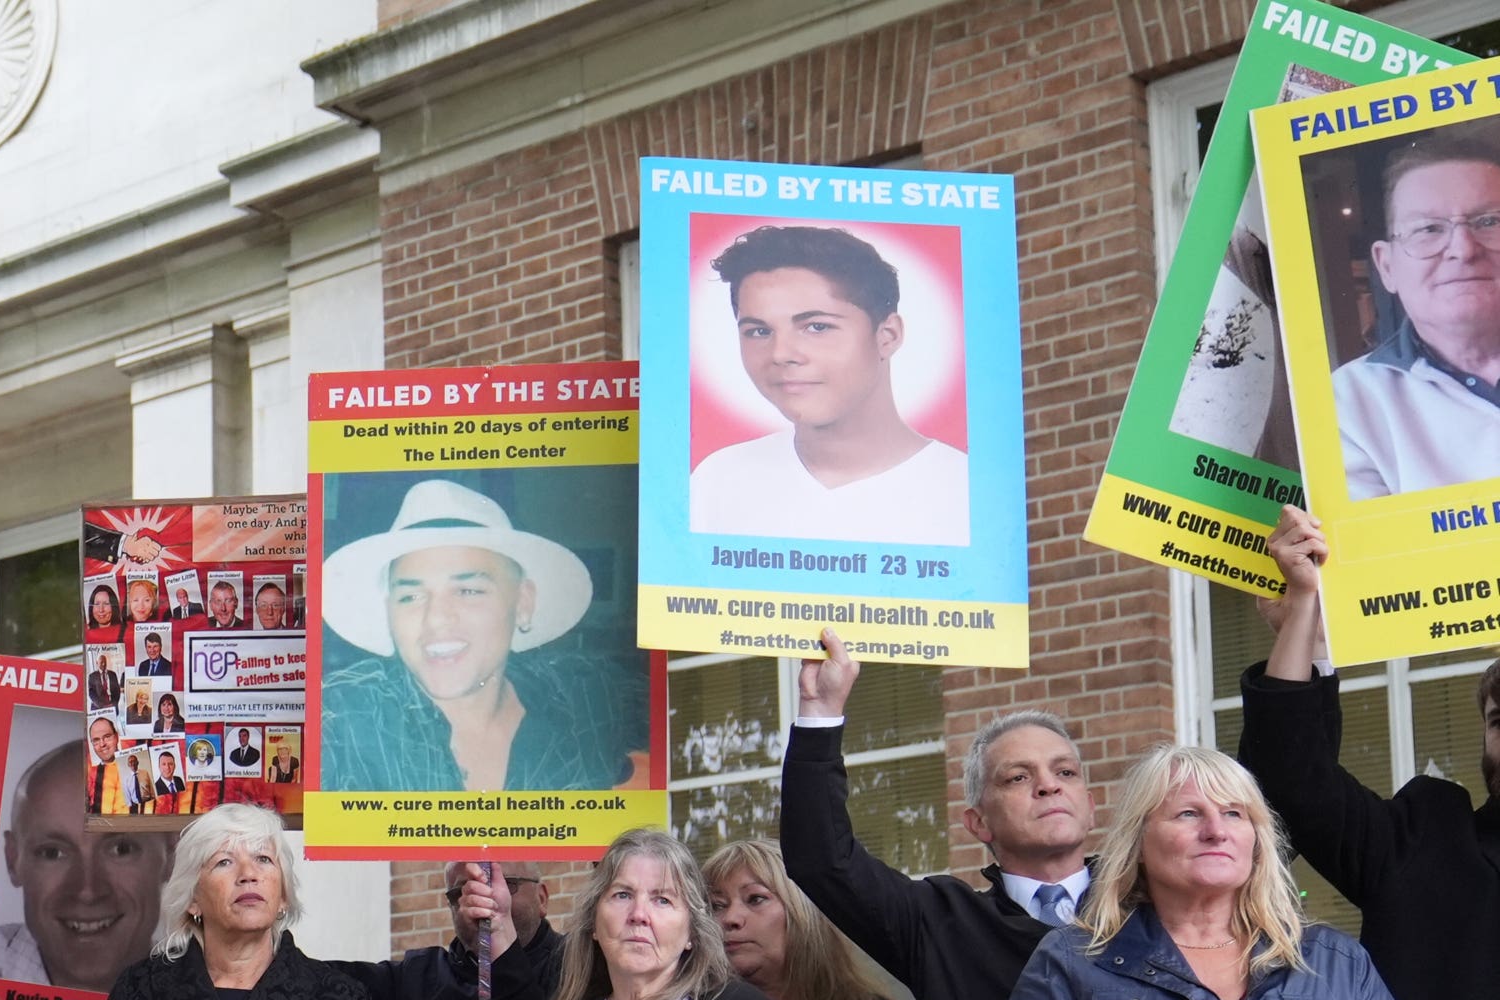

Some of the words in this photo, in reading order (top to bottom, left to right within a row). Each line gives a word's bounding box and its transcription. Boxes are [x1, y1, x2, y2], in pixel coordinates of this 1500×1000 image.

[1263, 1, 1376, 62] FAILED
[1381, 43, 1429, 77] BY
[1290, 95, 1417, 141] FAILED
[1430, 80, 1477, 112] BY
[652, 169, 767, 197] FAILED
[779, 176, 820, 200] BY
[829, 179, 892, 204] THE
[902, 183, 999, 209] STATE
[329, 385, 431, 408] FAILED
[445, 384, 481, 404] BY
[492, 382, 544, 402] THE
[557, 378, 639, 400] STATE
[344, 424, 388, 437] Dead
[394, 422, 447, 435] within
[454, 421, 475, 434] 20
[481, 420, 522, 435] days
[528, 418, 546, 431] of
[552, 416, 629, 431] entering
[1194, 454, 1262, 495] Sharon
[223, 505, 258, 516] Maybe
[1431, 505, 1488, 533] Nick
[227, 520, 247, 528] one
[251, 518, 272, 530] day.
[275, 517, 298, 527] And
[245, 546, 265, 555] had
[268, 546, 286, 554] not
[712, 546, 784, 569] Jayden
[790, 550, 867, 573] Booroff
[881, 555, 906, 575] 23
[916, 560, 949, 578] yrs
[166, 576, 181, 584] Peter
[235, 656, 271, 669] Failing
[274, 655, 284, 665] to
[236, 672, 280, 686] Patients
[283, 669, 306, 681] safe
[341, 801, 387, 810] www.
[394, 801, 432, 810] cure
[439, 797, 500, 810] mental
[507, 797, 564, 810] health
[571, 797, 625, 809] .co.uk
[388, 824, 576, 840] #matthewscampaign
